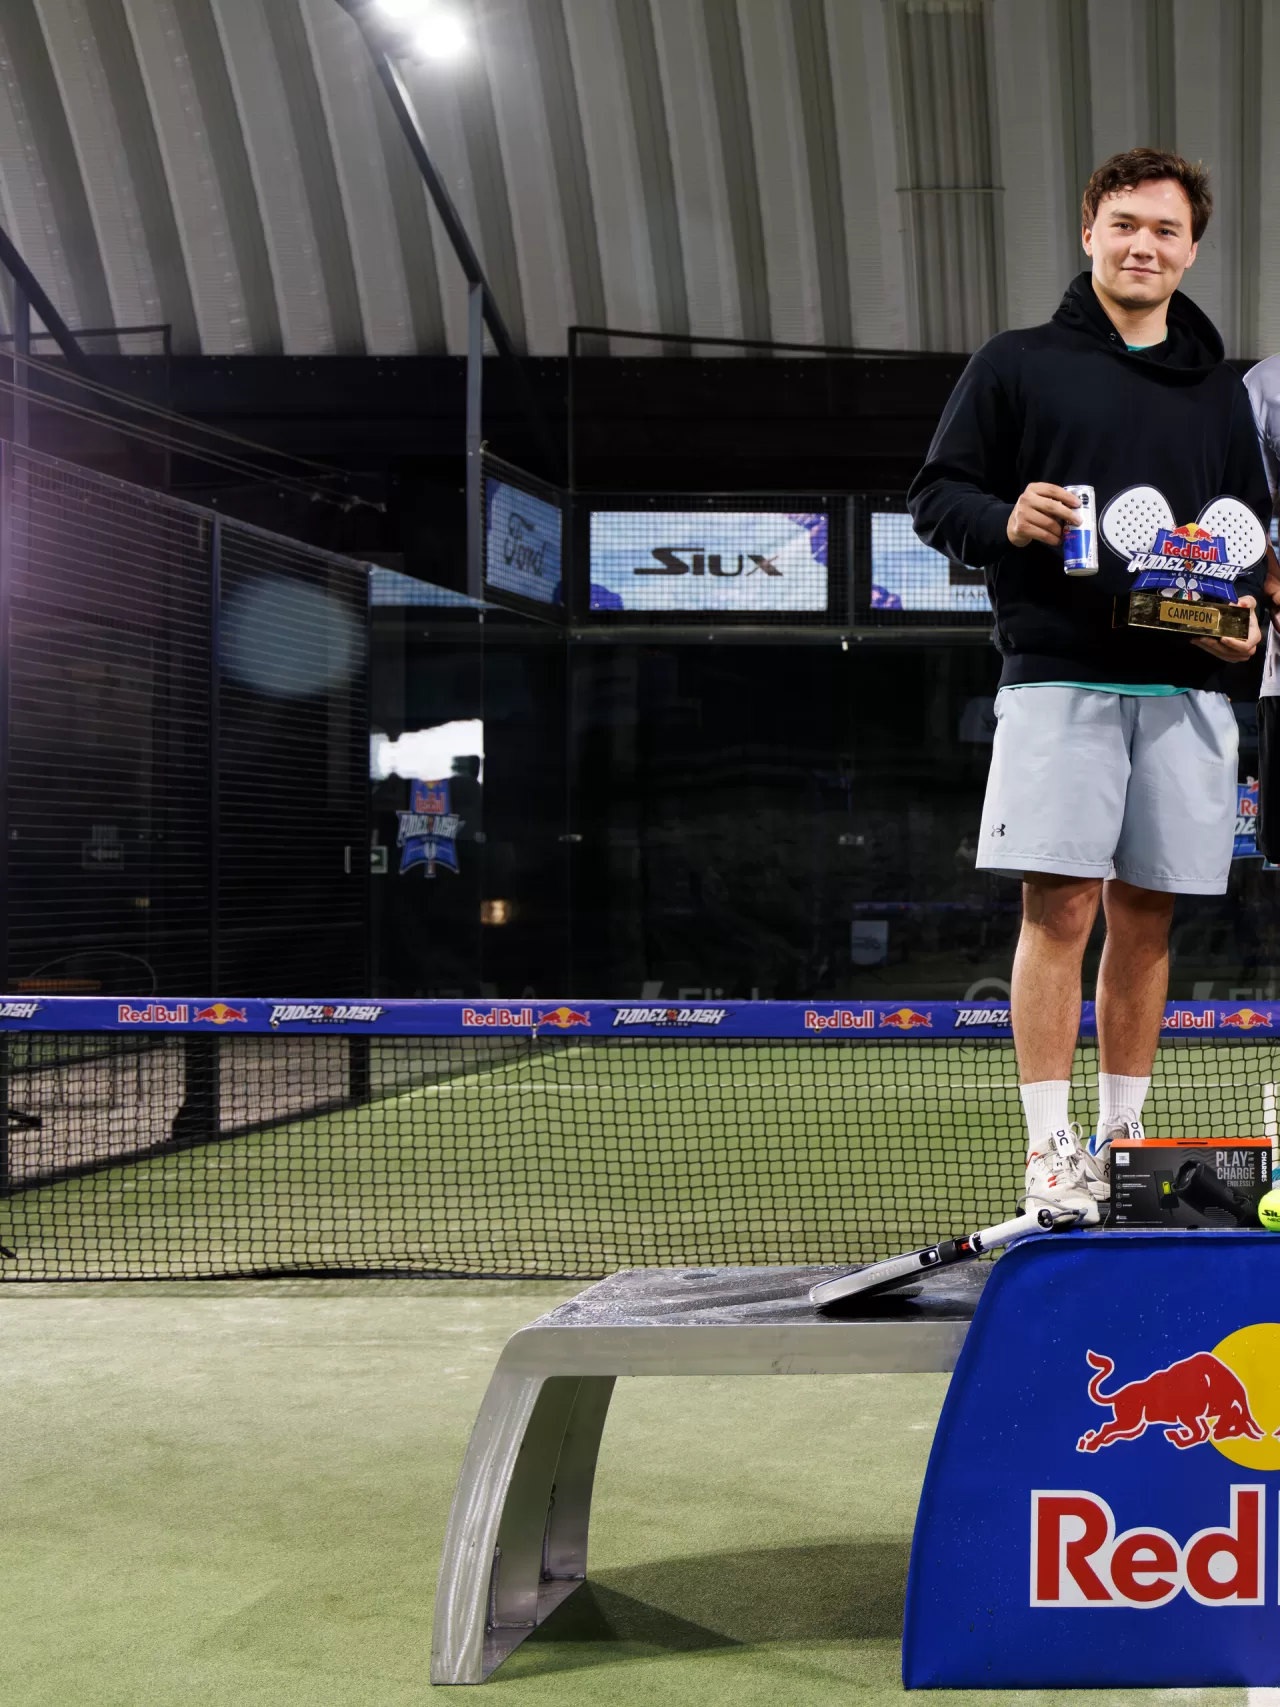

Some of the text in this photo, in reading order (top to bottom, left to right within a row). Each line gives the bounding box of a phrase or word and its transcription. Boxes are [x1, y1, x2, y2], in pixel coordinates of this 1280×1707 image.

[502, 511, 550, 578] Ford
[1163, 540, 1218, 562] Red Bull
[1127, 553, 1243, 581] PADEL DASH
[956, 589, 986, 599] HAR
[1240, 797, 1259, 817] Re
[0, 1003, 38, 1018] ASH
[118, 1004, 189, 1023] Red Bull
[269, 1005, 384, 1023] PADEL DASH
[462, 1008, 532, 1026] Red Bull
[612, 1008, 726, 1026] PADEL DASH
[804, 1010, 875, 1029] Red Bull
[954, 1009, 1010, 1027] PADEL
[1160, 1010, 1215, 1029] ed Bull
[1216, 1151, 1248, 1167] PLAY
[1216, 1167, 1256, 1180] CHARGE
[1033, 1487, 1263, 1606] Red
